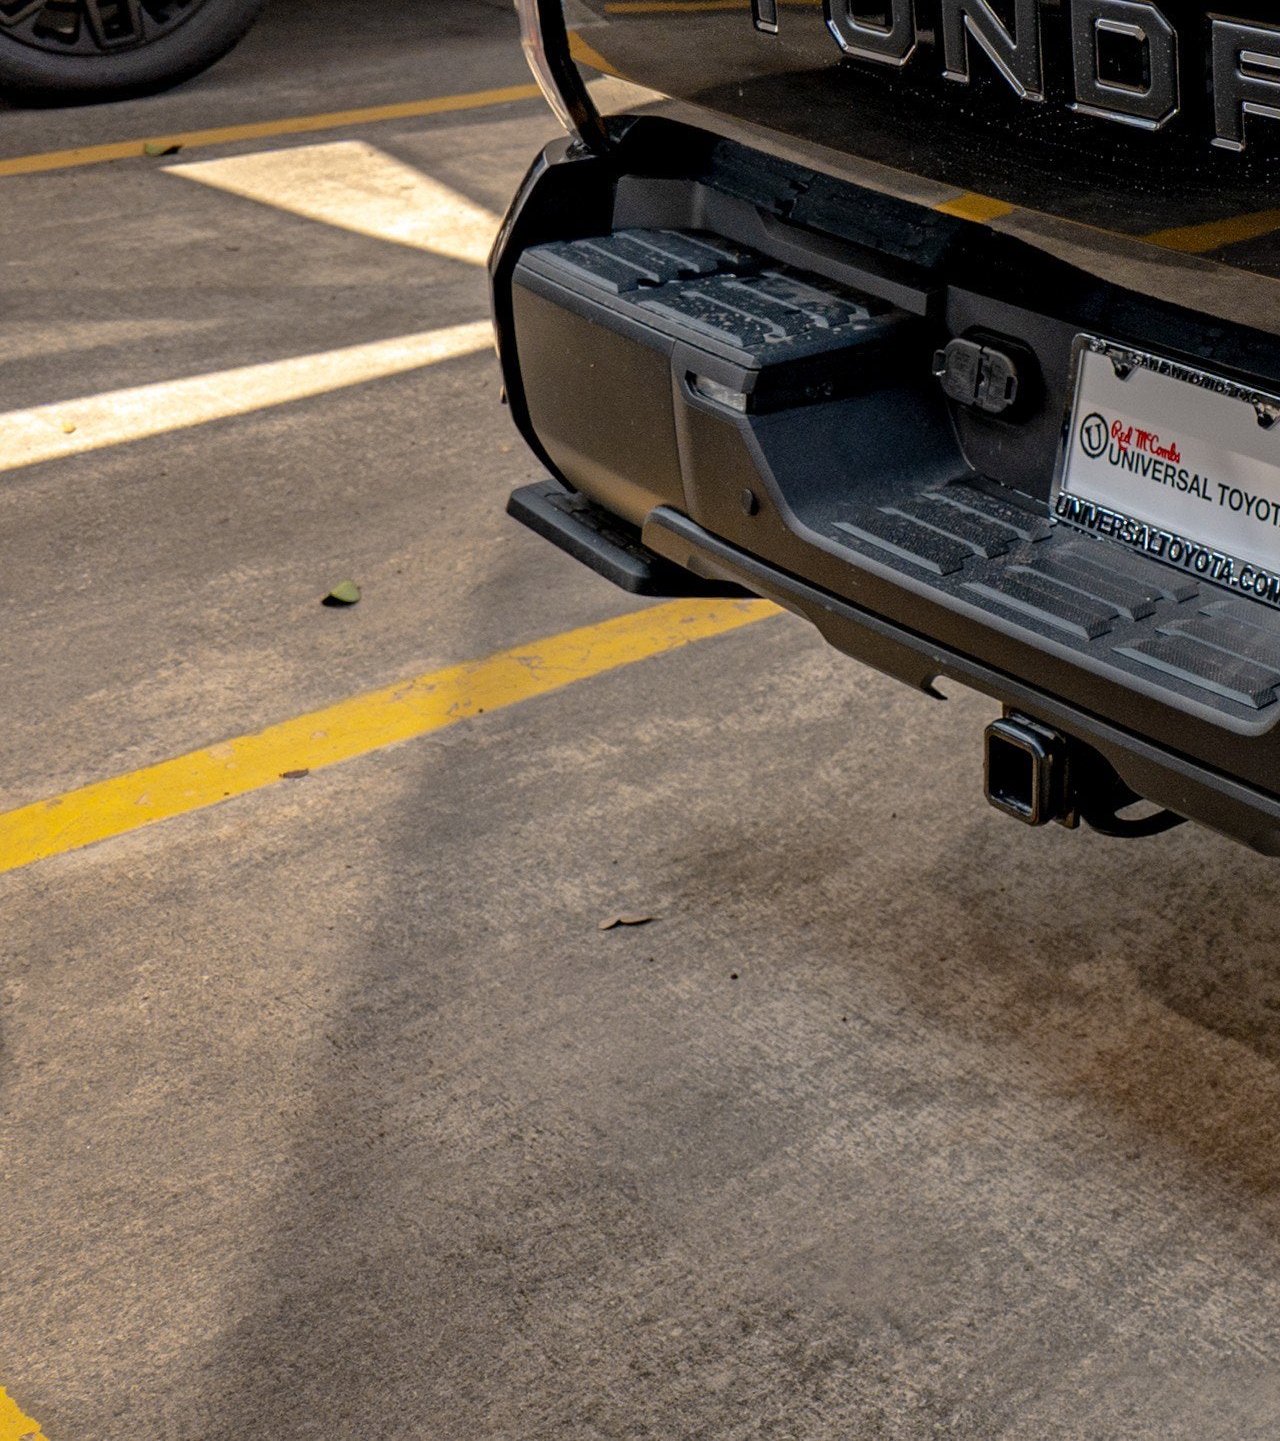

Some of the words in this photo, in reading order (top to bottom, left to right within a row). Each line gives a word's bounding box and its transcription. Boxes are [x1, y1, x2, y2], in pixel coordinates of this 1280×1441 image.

[1132, 353, 1162, 374] SAN
[1111, 419, 1133, 446] Red
[1134, 427, 1182, 464] McCombs
[1107, 442, 1213, 502] UNIVERSAL
